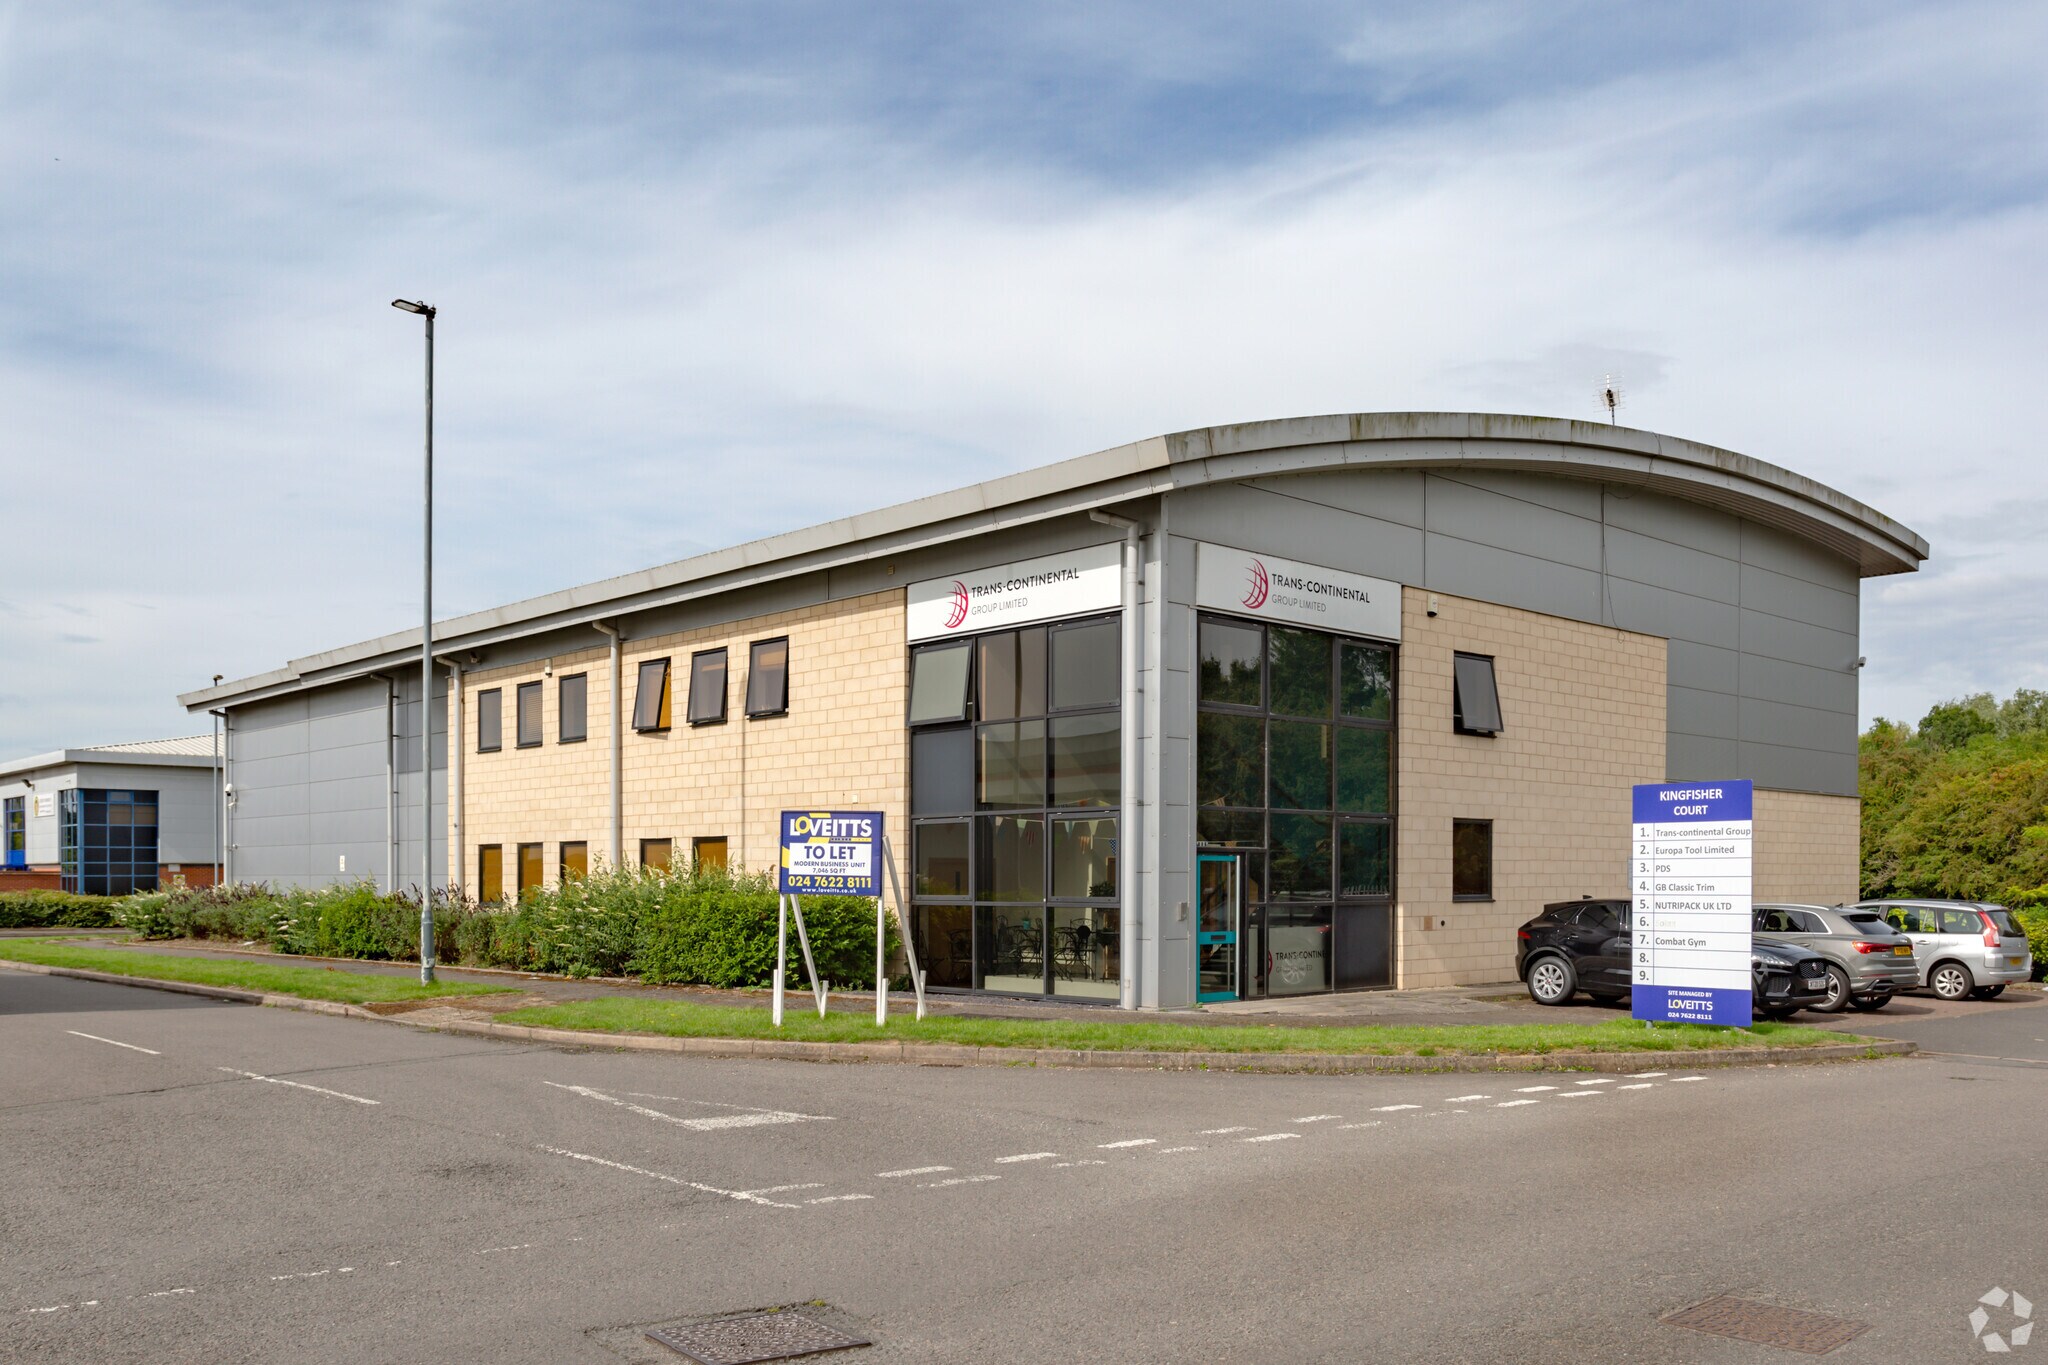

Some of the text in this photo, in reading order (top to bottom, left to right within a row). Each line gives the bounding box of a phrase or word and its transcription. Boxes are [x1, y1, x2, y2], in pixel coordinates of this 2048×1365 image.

[971, 568, 1079, 598] TRANS-CONTINENTAL
[1272, 573, 1370, 603] TRANS-CONTINENTAL
[971, 597, 1028, 615] GROUP LIMITED
[1272, 594, 1327, 612] GROUP LIMITED
[1660, 789, 1723, 801] KINGFISHER
[1673, 805, 1708, 815] COURT
[790, 816, 872, 837] LOVEITTS
[1640, 828, 1751, 837] 1. Trans-continental Group
[804, 846, 856, 859] TO LET
[1640, 845, 1650, 854] 2.
[1655, 847, 1683, 856] Europa
[1704, 846, 1735, 854] Limited
[1640, 863, 1650, 872] 3.
[788, 876, 872, 888] 024 7622 8111
[1640, 882, 1650, 891] 4.
[1640, 900, 1650, 909] 5.
[1655, 902, 1700, 910] NUTRIPACK
[1716, 902, 1732, 910] LTD
[1640, 916, 1650, 926] 6.
[1640, 934, 1706, 948] 7. Combat Gym
[1640, 953, 1649, 962] 8.
[1640, 970, 1649, 980] 9.
[1668, 999, 1713, 1010] LOVEITTS
